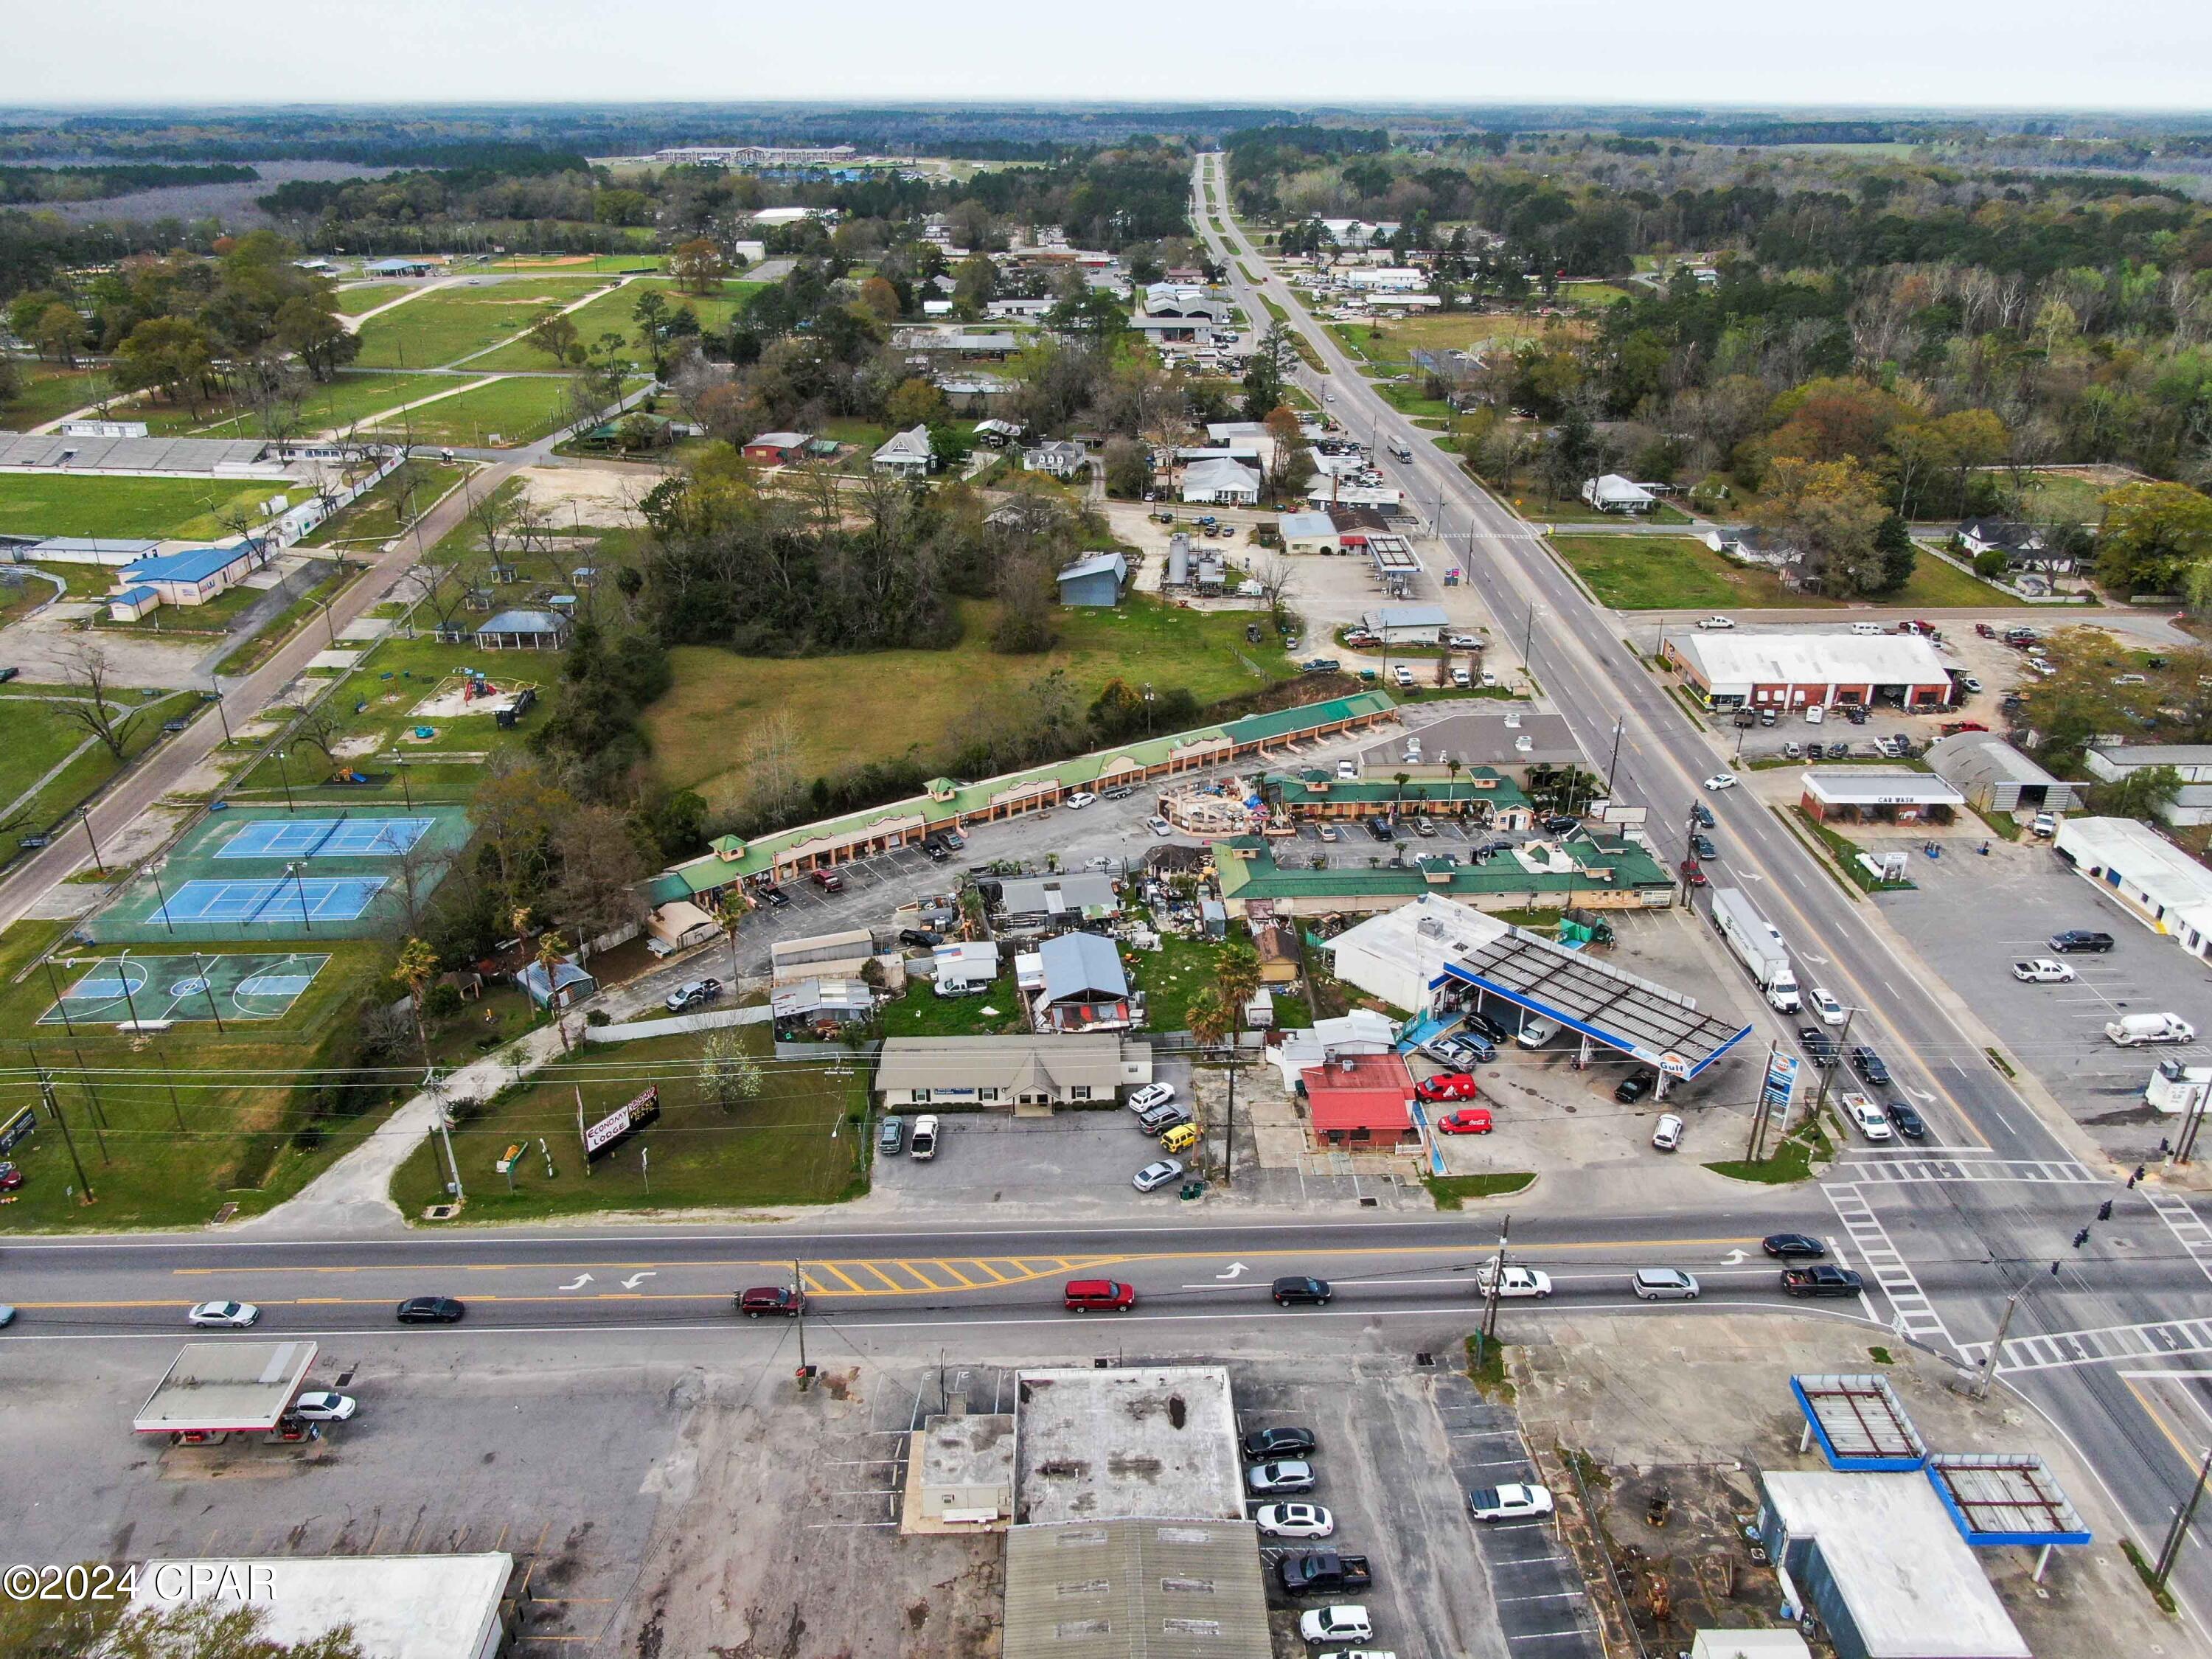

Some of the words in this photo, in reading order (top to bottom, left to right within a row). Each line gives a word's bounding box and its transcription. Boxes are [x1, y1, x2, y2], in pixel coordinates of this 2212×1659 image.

[1660, 1062, 1684, 1072] Gulf
[588, 1110, 627, 1138] ECONOMY
[594, 1123, 625, 1145] LODGE
